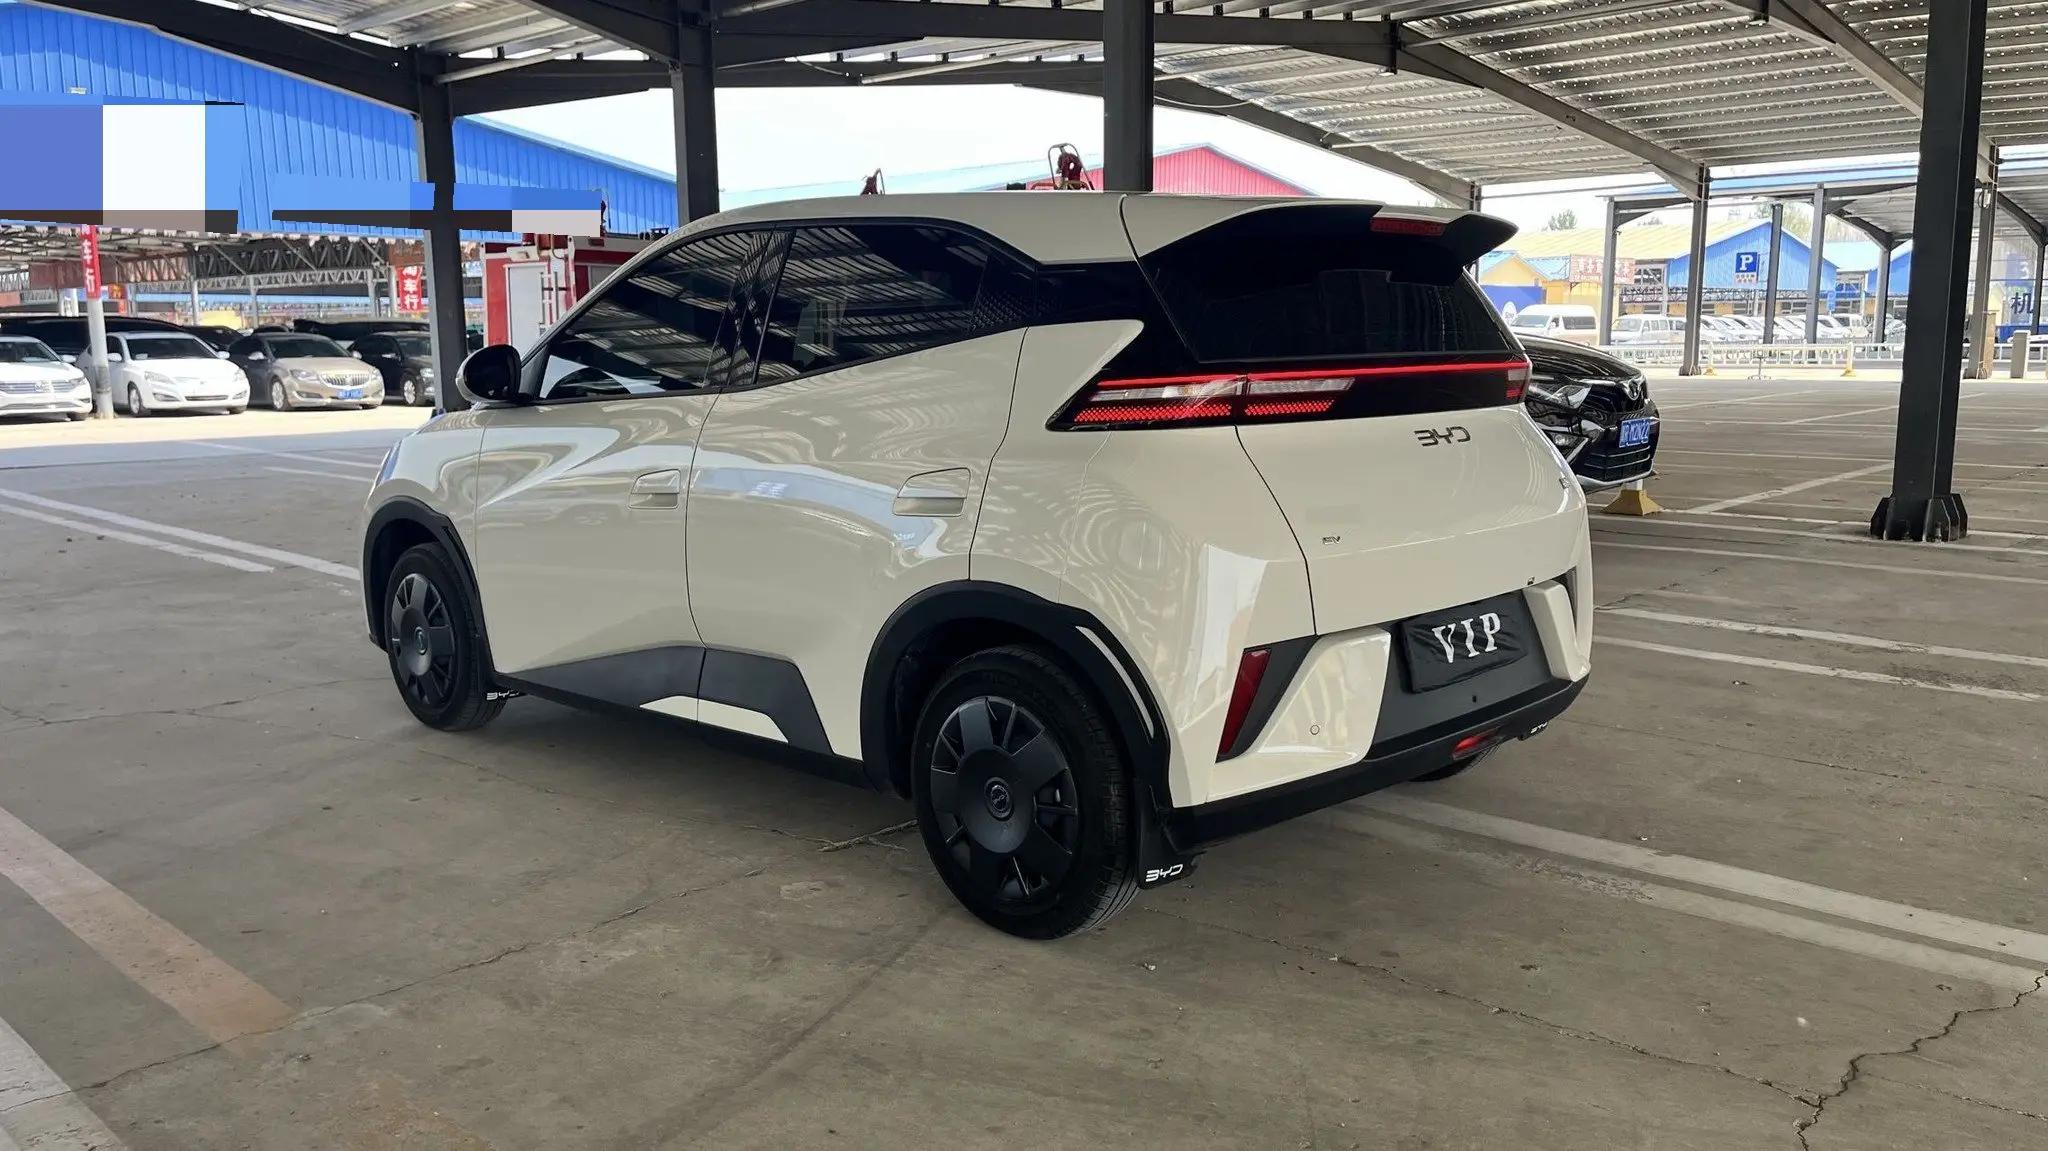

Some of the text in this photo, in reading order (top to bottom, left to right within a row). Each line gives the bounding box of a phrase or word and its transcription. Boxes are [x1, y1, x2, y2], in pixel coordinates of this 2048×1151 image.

[1740, 254, 1753, 271] P
[1414, 426, 1471, 447] BYD
[1431, 612, 1501, 664] VIP
[1145, 864, 1184, 882] BYD
